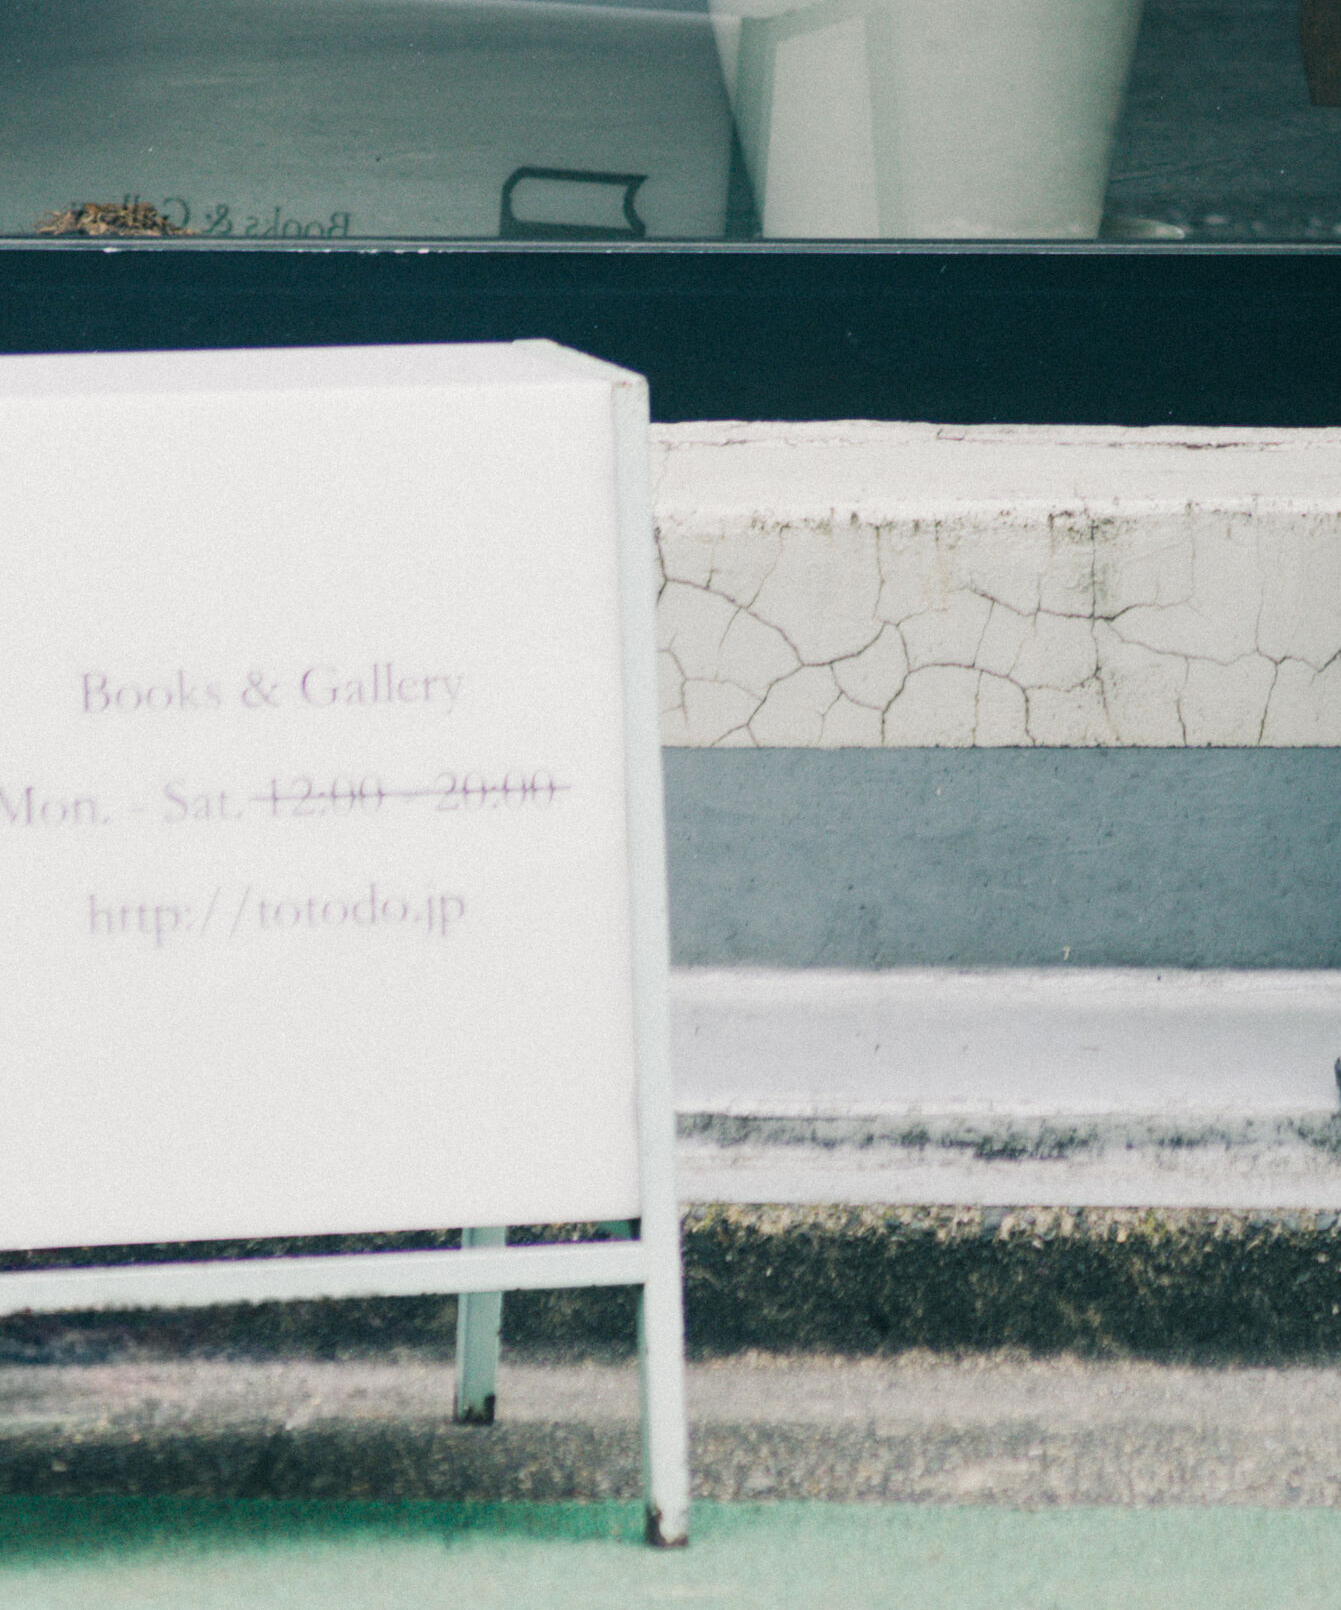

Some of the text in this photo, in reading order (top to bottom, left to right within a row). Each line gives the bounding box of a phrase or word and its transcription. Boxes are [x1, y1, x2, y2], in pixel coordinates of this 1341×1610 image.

[80, 661, 464, 715] Books & Gallery
[0, 784, 110, 827] Mon.
[163, 777, 243, 823] Sat.
[88, 881, 467, 949] http://totodo.jp
